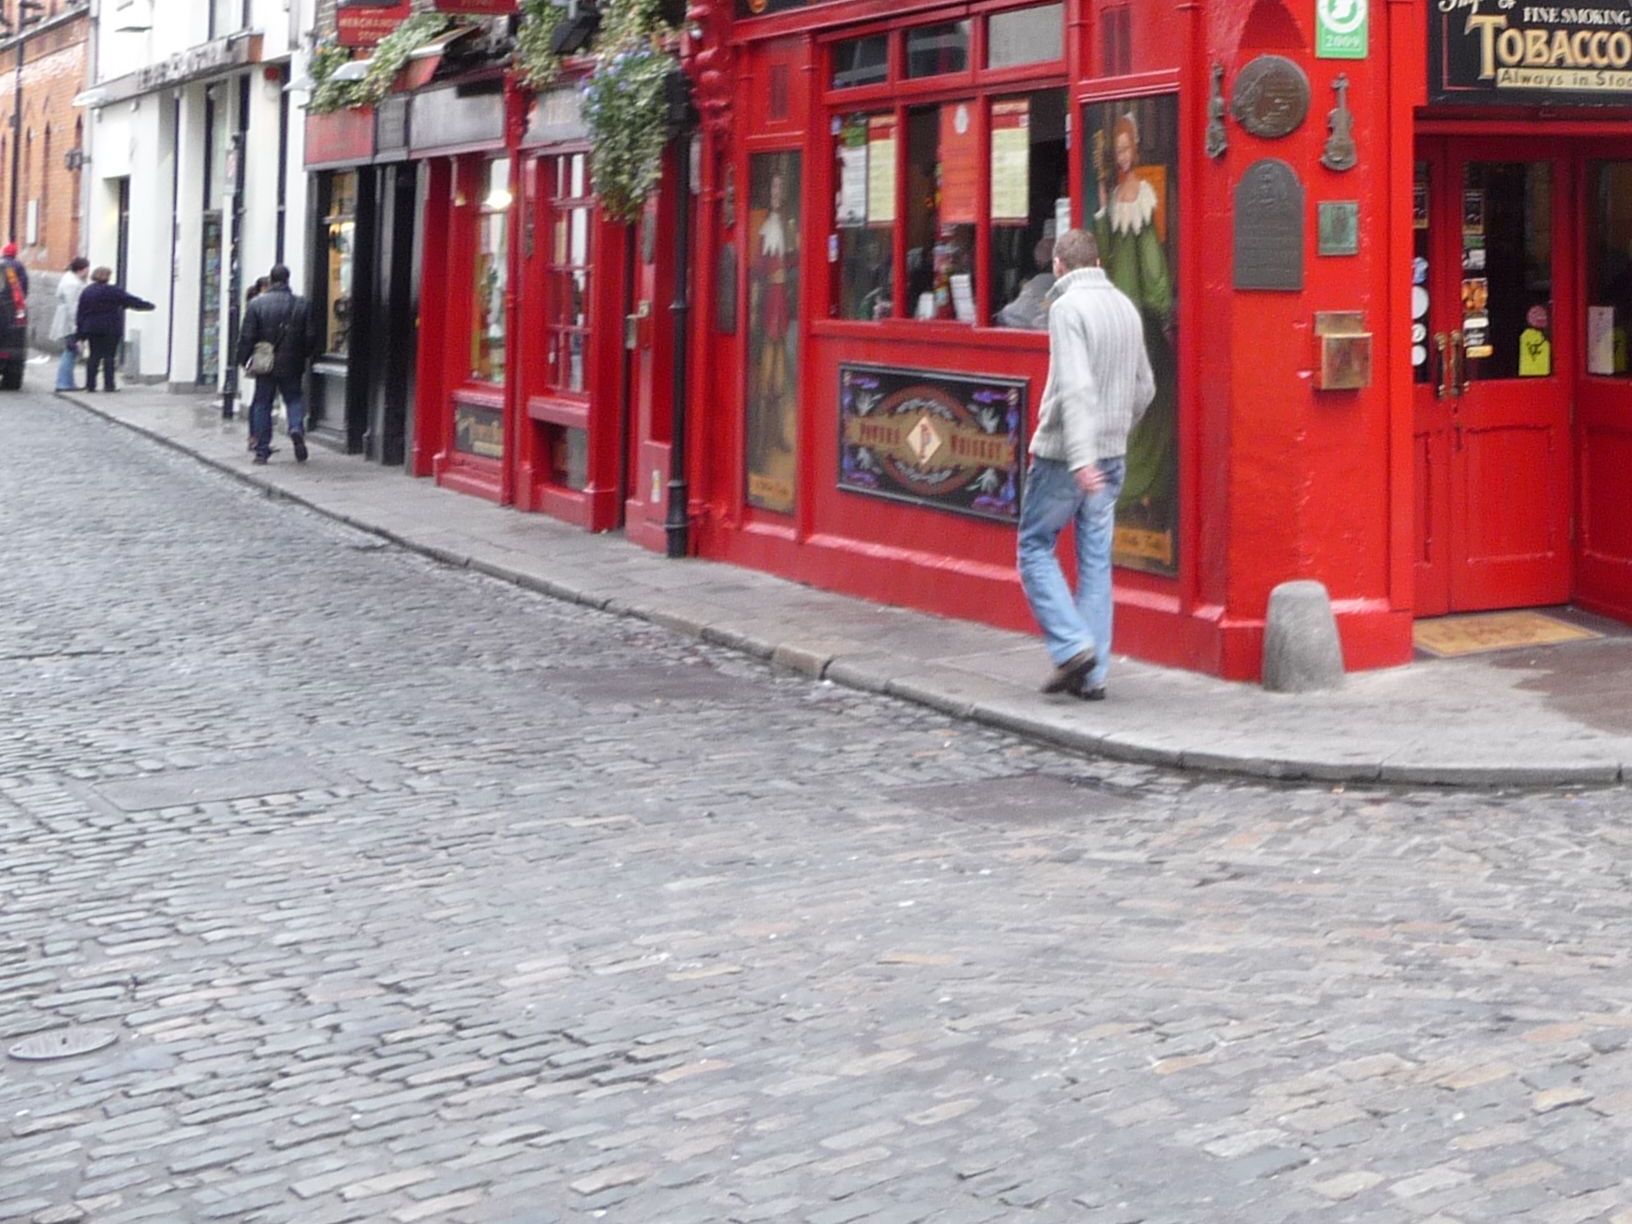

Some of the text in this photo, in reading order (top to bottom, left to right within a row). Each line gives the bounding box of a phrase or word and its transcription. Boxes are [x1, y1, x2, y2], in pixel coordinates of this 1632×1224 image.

[1522, 6, 1632, 26] FINE SMOKING
[1499, 69, 1564, 88] Always
[1572, 71, 1590, 86] in
